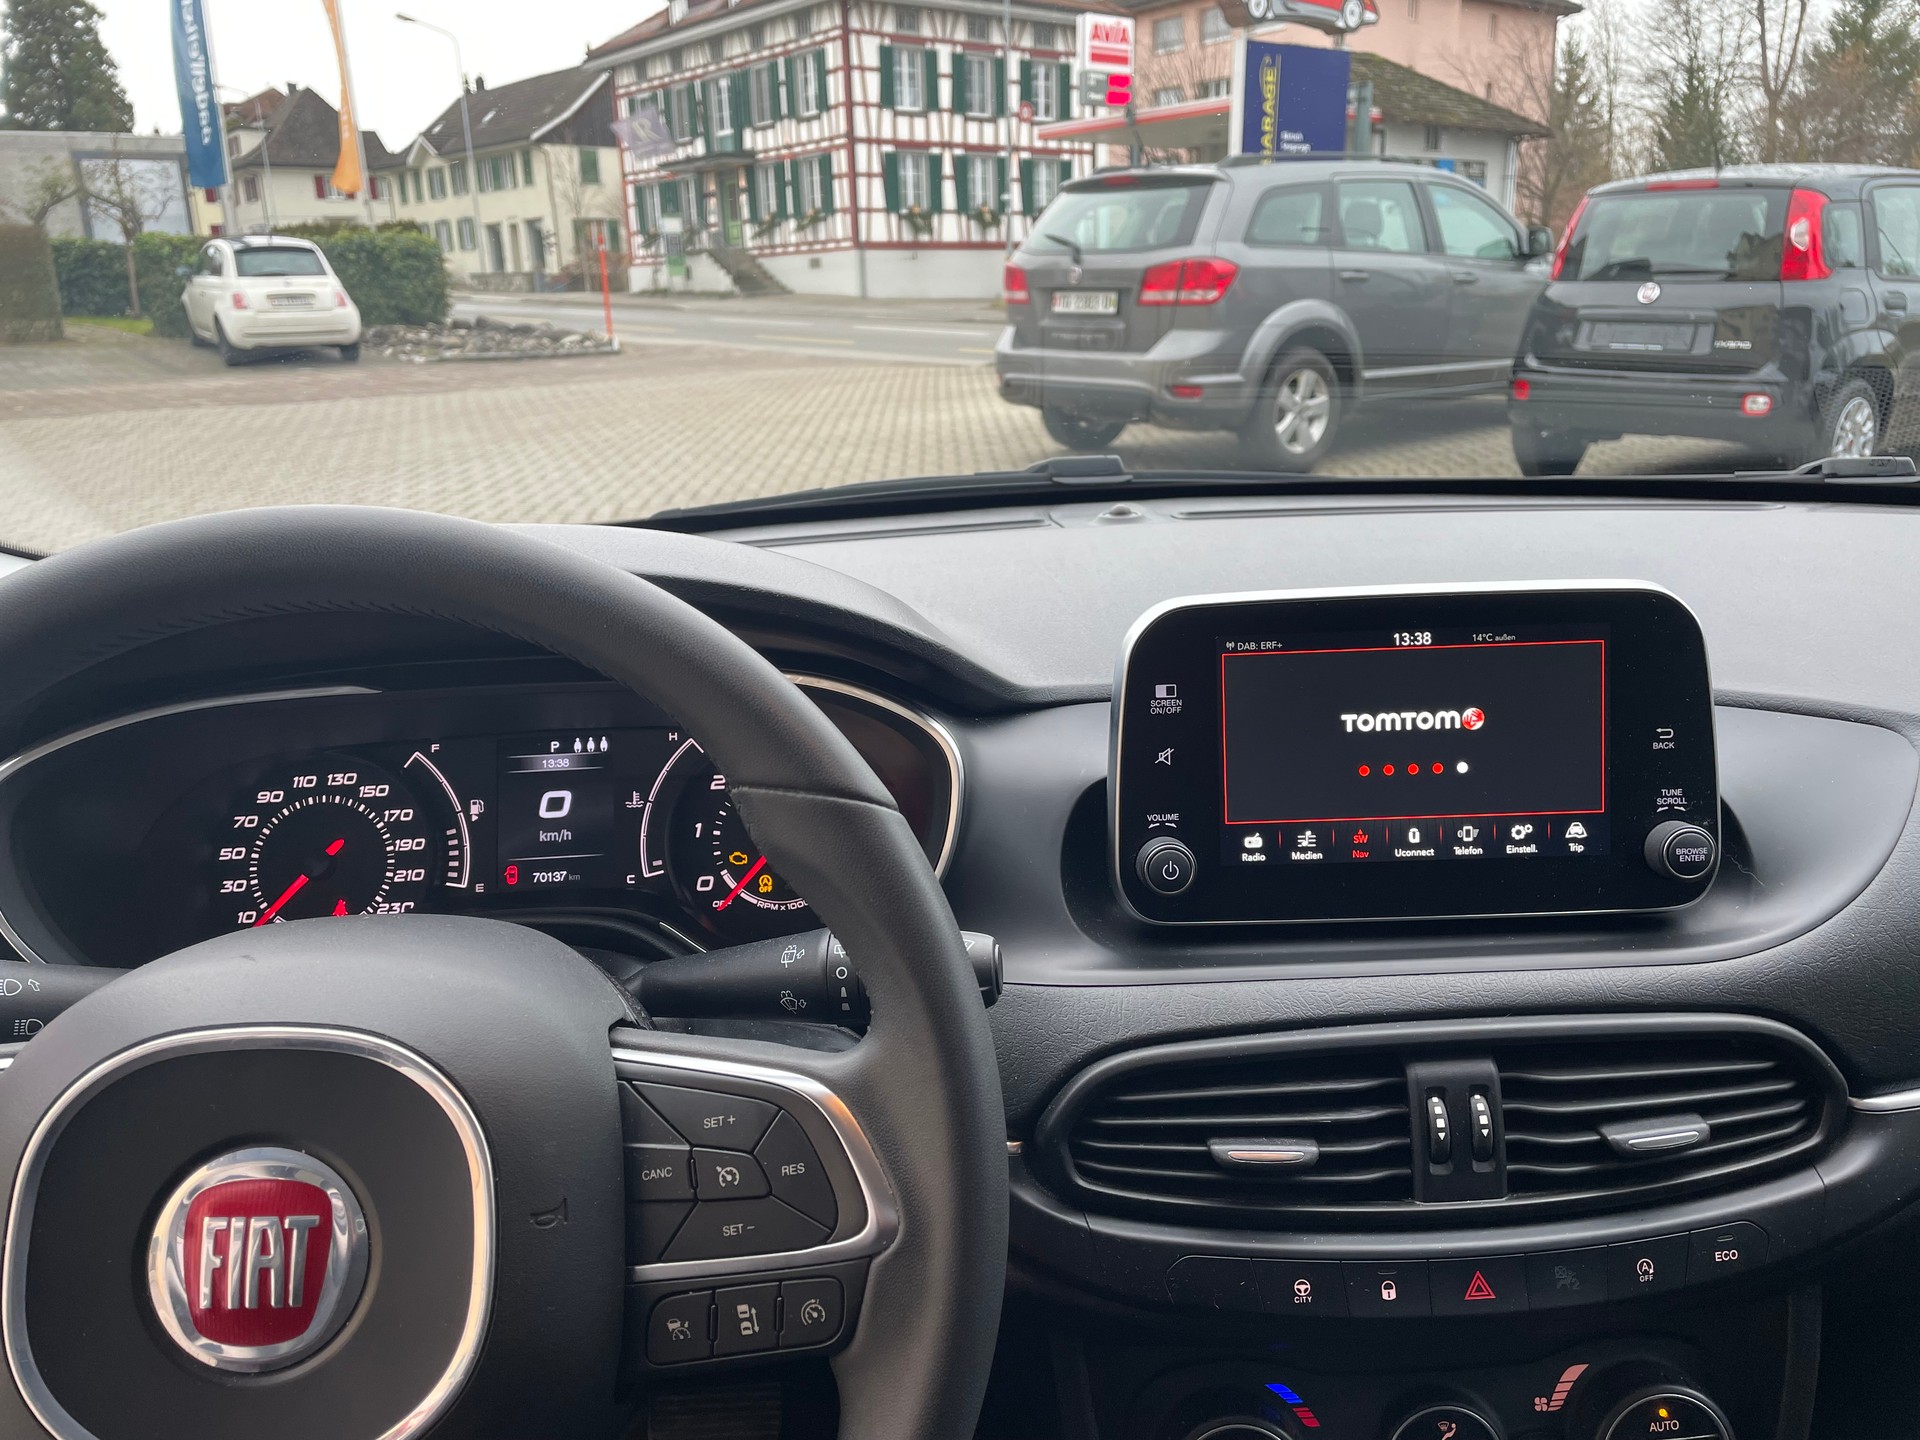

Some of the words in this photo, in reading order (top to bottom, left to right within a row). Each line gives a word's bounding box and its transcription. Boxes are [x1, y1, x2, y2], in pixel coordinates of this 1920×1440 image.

[1393, 632, 1432, 646] 13:38
[1472, 633, 1493, 642] 14°C
[1495, 633, 1516, 642] außen
[1237, 642, 1258, 651] DAB:
[1260, 641, 1283, 650] ERF+
[1150, 699, 1182, 707] SCREEN
[1150, 706, 1182, 714] ON/OFF
[668, 733, 678, 741] H
[431, 744, 440, 752] F
[551, 741, 560, 753] P
[1652, 741, 1675, 749] BACK
[542, 758, 570, 769] 13:38
[292, 775, 317, 788] 110
[327, 772, 357, 786] 130
[710, 775, 726, 790] 2
[257, 790, 284, 803] 90
[358, 785, 389, 798] 150
[1661, 788, 1683, 797] TUNE
[538, 790, 572, 819] 0
[1656, 796, 1688, 805] SCROLL
[383, 808, 414, 822] 170
[1147, 813, 1180, 822] VOLUME
[233, 815, 258, 828] 70
[539, 828, 572, 843] km/h
[694, 822, 703, 838] 1
[394, 838, 425, 851] 190
[1353, 834, 1369, 844] SW
[1394, 848, 1435, 858] Uconnect
[1453, 846, 1483, 856] Telefon
[1506, 844, 1538, 854] Einstell.
[1568, 842, 1584, 853] Trip
[1675, 847, 1708, 855] BROWSE
[219, 847, 246, 860] 50
[1241, 853, 1266, 862] Radio
[1291, 851, 1323, 861] Medien
[1352, 850, 1370, 858] Nav
[1679, 854, 1706, 863] ENTER
[394, 868, 425, 882] 210
[532, 871, 568, 883] 70137
[568, 872, 581, 881] km
[626, 875, 635, 884] C
[220, 879, 247, 892] 30
[475, 883, 484, 892] E
[696, 876, 714, 891] 0
[757, 901, 779, 910] RPM
[237, 911, 257, 924] 10
[703, 1116, 724, 1129] SET
[641, 1167, 673, 1182] CANC
[781, 1163, 805, 1177] RES
[722, 1224, 743, 1237] SET
[1715, 1249, 1738, 1262] ECO
[199, 1214, 321, 1310] FIAT
[1639, 1274, 1654, 1282] OFF
[1294, 1296, 1312, 1304] CITY
[1649, 1420, 1680, 1432] AUTO
